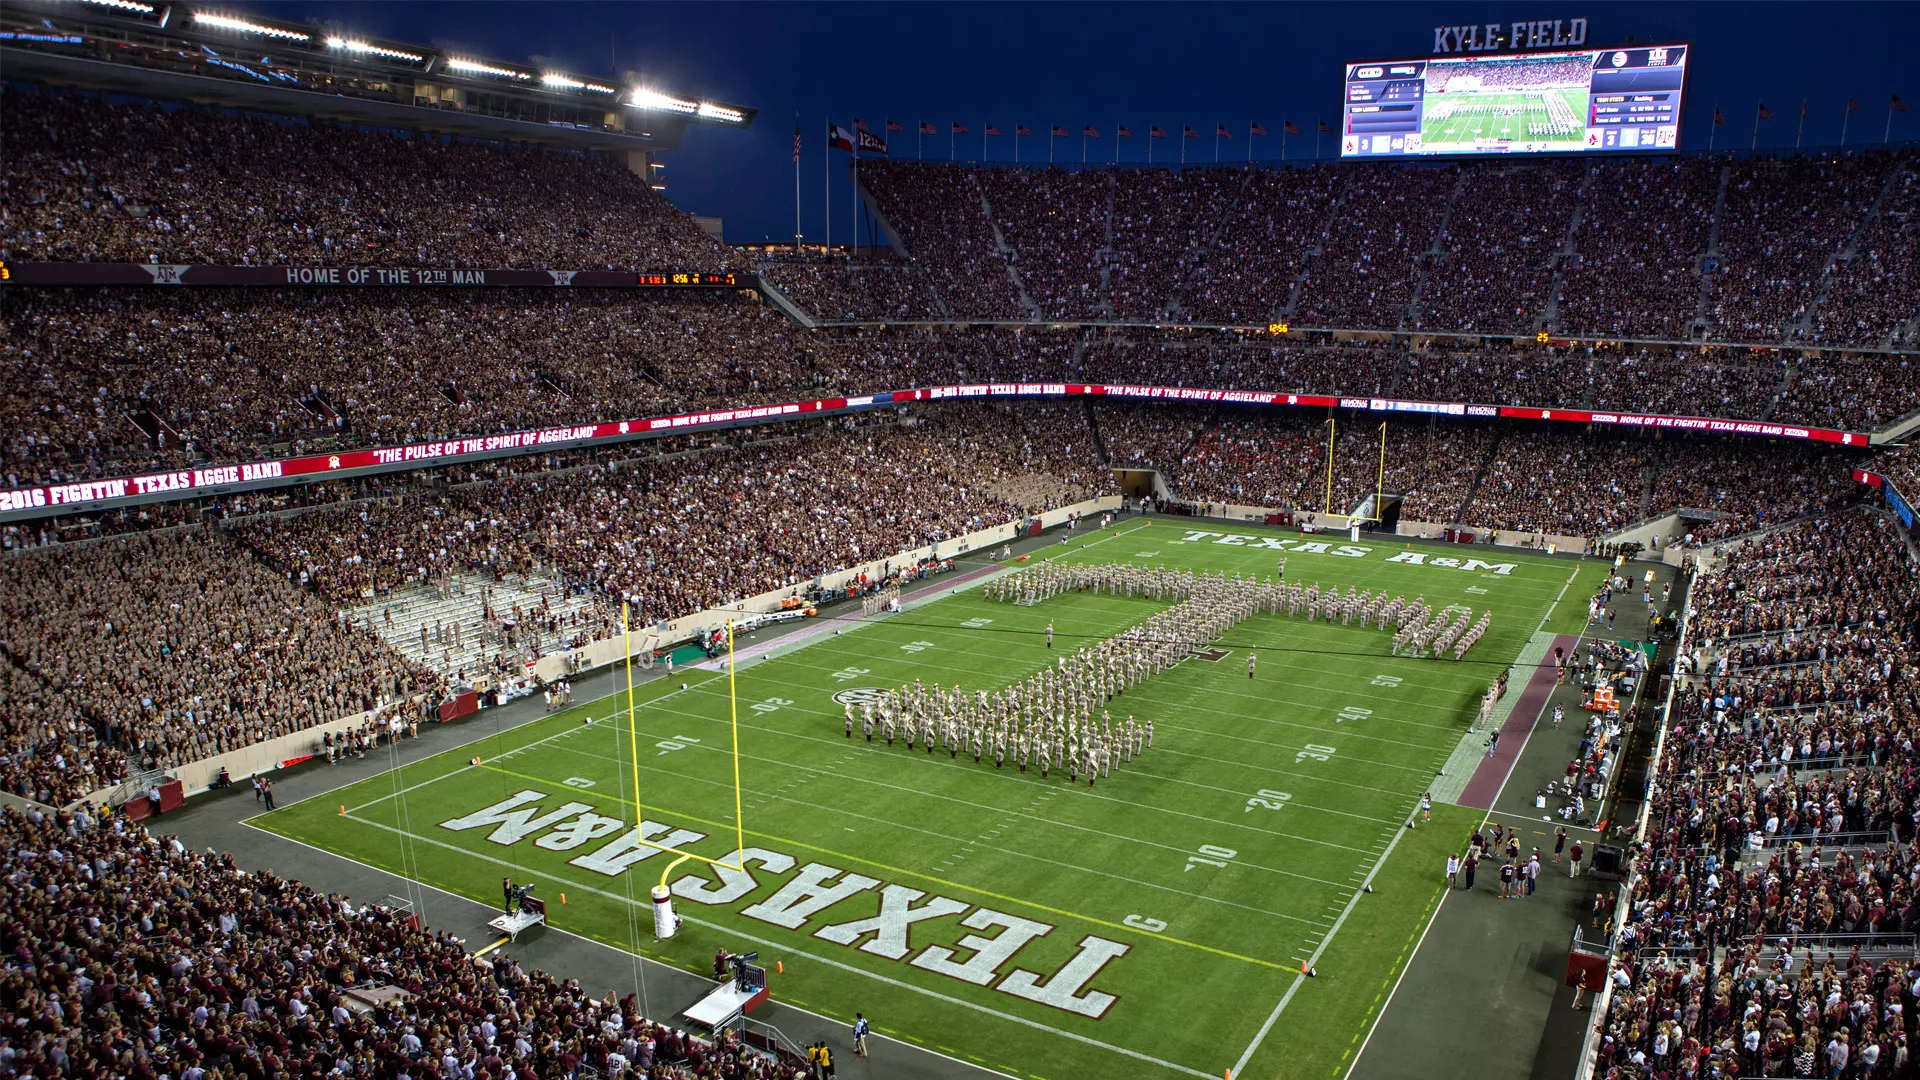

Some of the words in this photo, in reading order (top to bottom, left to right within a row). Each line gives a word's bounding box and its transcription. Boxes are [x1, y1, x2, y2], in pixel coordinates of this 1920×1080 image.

[1433, 24, 1501, 53] KYLE
[1509, 18, 1588, 48] FIELD
[287, 268, 340, 284] HOME
[347, 269, 369, 284] OF
[377, 269, 409, 284] THE
[416, 270, 447, 284] 12TH
[453, 271, 485, 284] MAN
[673, 274, 688, 283] 12:56
[1537, 332, 1549, 342] 25
[990, 384, 1016, 395] TEXAS
[1103, 386, 1123, 395] "THE
[1124, 387, 1150, 396] PULSE
[1151, 388, 1162, 397] OF
[1164, 388, 1180, 398] THE
[1181, 390, 1209, 400] SPIRIT
[1210, 390, 1222, 400] OF
[1222, 391, 1276, 403] AGGIELAND"
[1620, 416, 1643, 425] HOME
[1644, 417, 1656, 425] OF
[1657, 418, 1672, 426] THE
[1673, 419, 1709, 429] FIGHTIN'
[1710, 421, 1735, 431] TEXAS
[1736, 423, 1760, 433] AGGIE
[1761, 425, 1782, 435] BAND
[373, 448, 403, 464] "THE
[405, 443, 442, 460] PULSE
[445, 441, 460, 455] OF
[463, 438, 484, 453] THE
[486, 434, 521, 450] SPIRIT
[523, 432, 536, 446] OF
[538, 425, 597, 444] AGGIELAND"
[0, 488, 46, 511] 2016
[49, 479, 129, 504] FIGHTIN'
[134, 472, 190, 494] TEXAS
[194, 466, 239, 487] AGGIE
[242, 461, 282, 481] BAND
[1180, 530, 1373, 558] TEXAS
[1384, 551, 1519, 575] A&M
[1370, 675, 1403, 687] 50
[1338, 706, 1373, 720] 40
[1296, 743, 1336, 761] 30
[1247, 789, 1293, 811] 20
[435, 788, 710, 877] A&M
[1188, 844, 1238, 868] 10
[670, 846, 1134, 1019] TEXAS
[1122, 914, 1169, 933] G
[611, 1058, 620, 1069] 12
